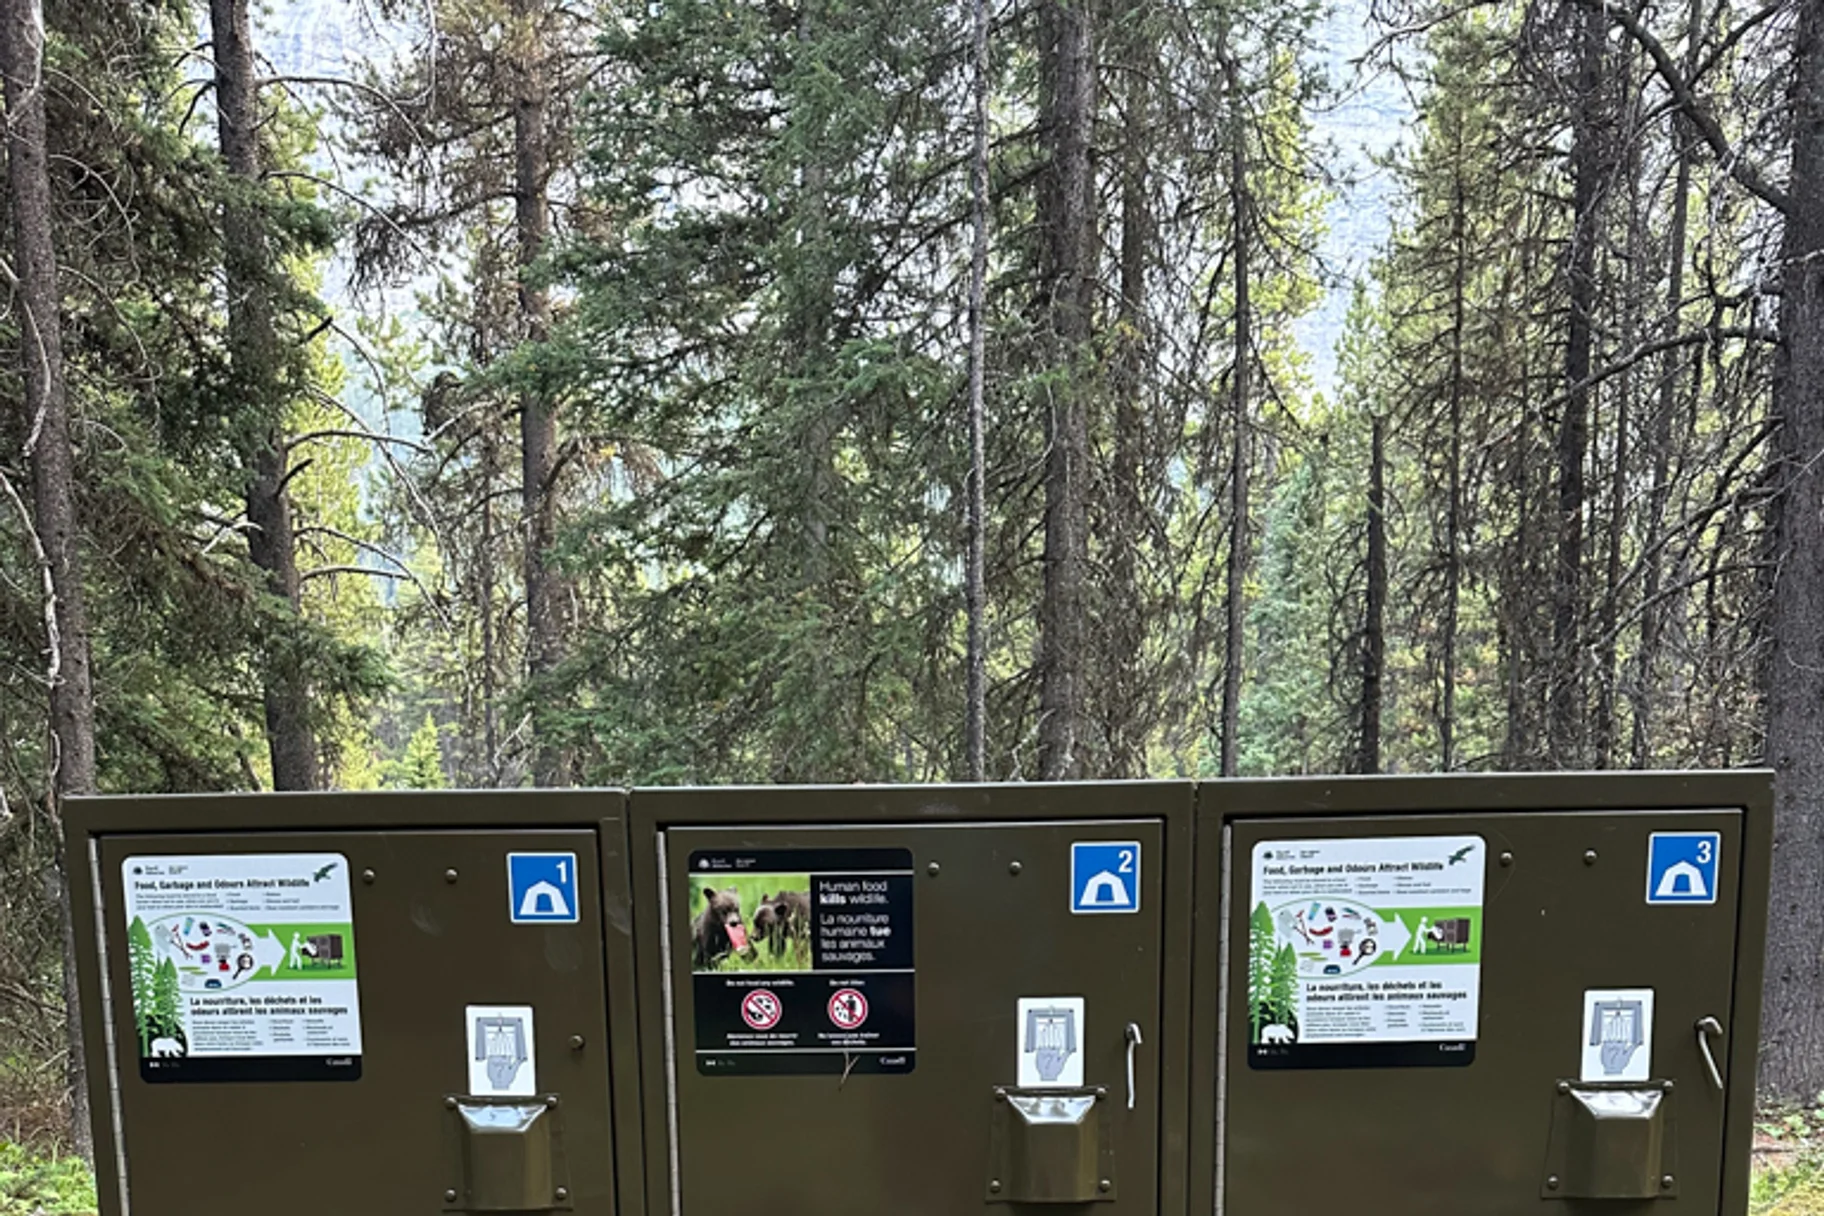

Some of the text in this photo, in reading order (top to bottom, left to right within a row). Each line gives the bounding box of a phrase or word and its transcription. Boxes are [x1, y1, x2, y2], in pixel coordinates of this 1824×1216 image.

[1697, 841, 1711, 863] 3
[1119, 850, 1132, 873] 2
[556, 861, 567, 884] 1
[1264, 862, 1444, 876] Food, Garbage and Odours Attract Wildlife
[135, 879, 309, 891] Food, Garbage and Odours Attract Wildlife
[820, 880, 887, 891] Human food
[820, 893, 888, 904] kills wildlife.
[820, 913, 889, 924] La nourriture
[821, 926, 891, 936] humaine tue
[821, 938, 885, 948] les animaux
[822, 952, 875, 964] sauvages.
